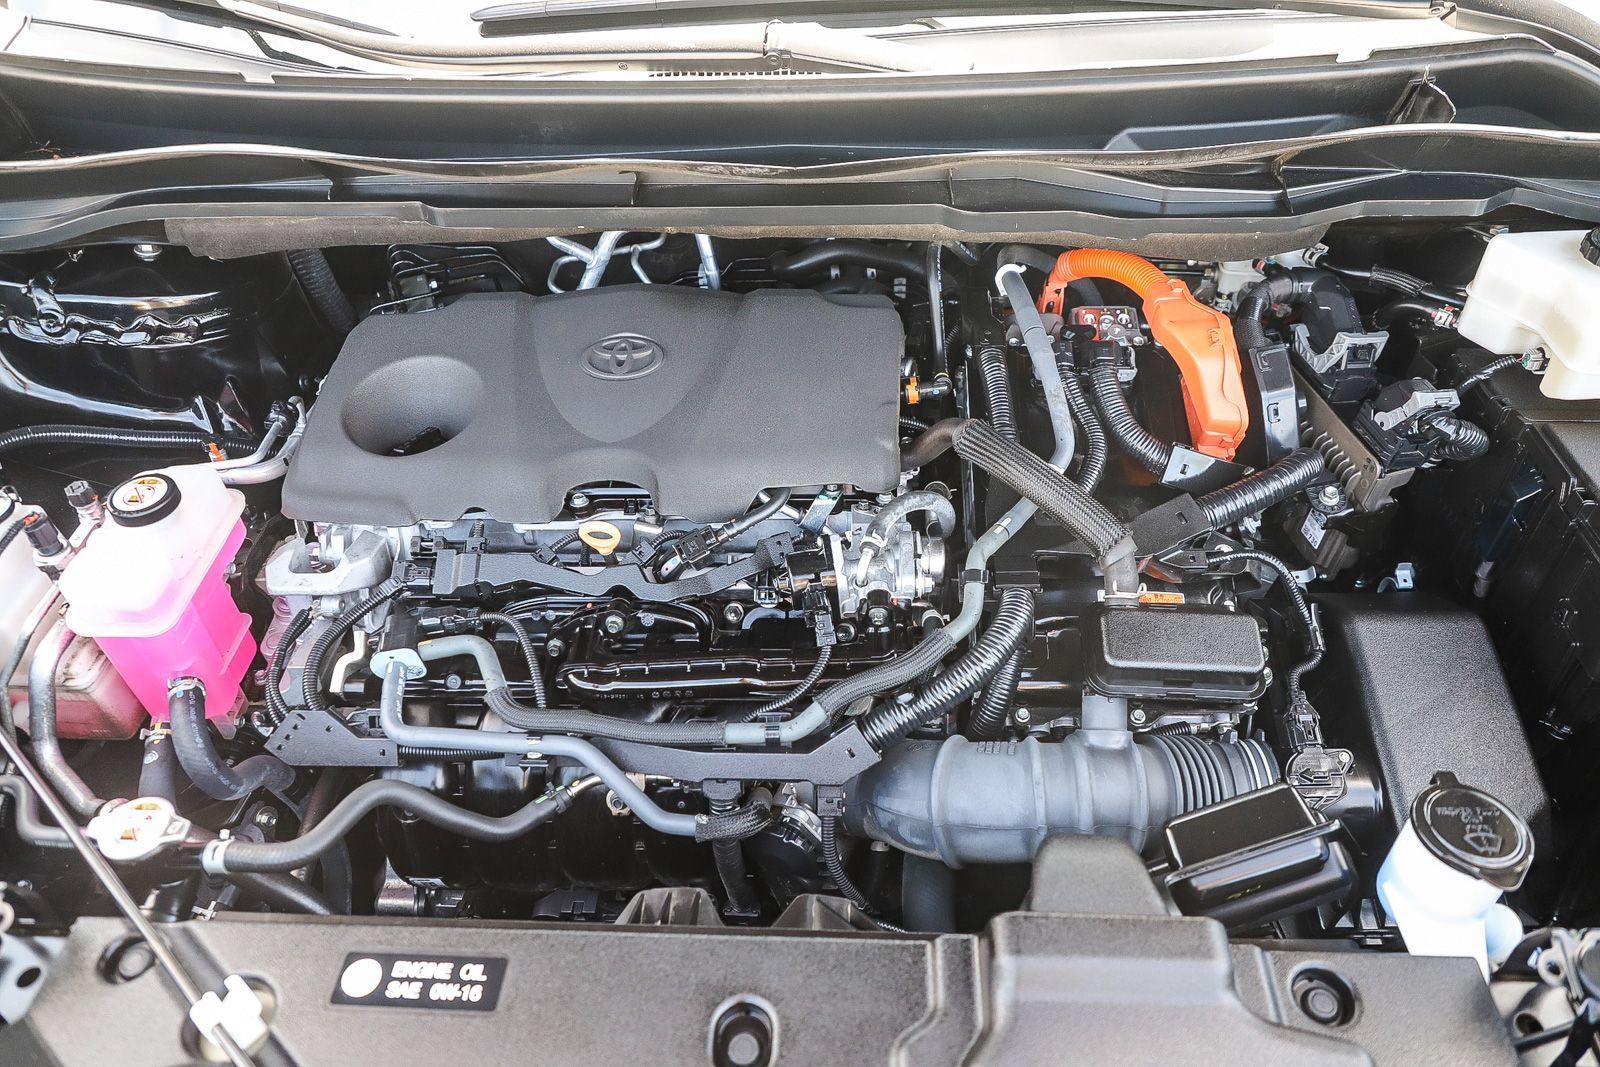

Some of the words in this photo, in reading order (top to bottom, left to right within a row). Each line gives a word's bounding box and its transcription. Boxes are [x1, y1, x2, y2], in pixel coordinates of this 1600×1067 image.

[391, 960, 454, 980] ENGINE
[459, 963, 487, 981] OIL
[385, 981, 423, 999] SAE
[429, 983, 483, 1002] 0W-16
